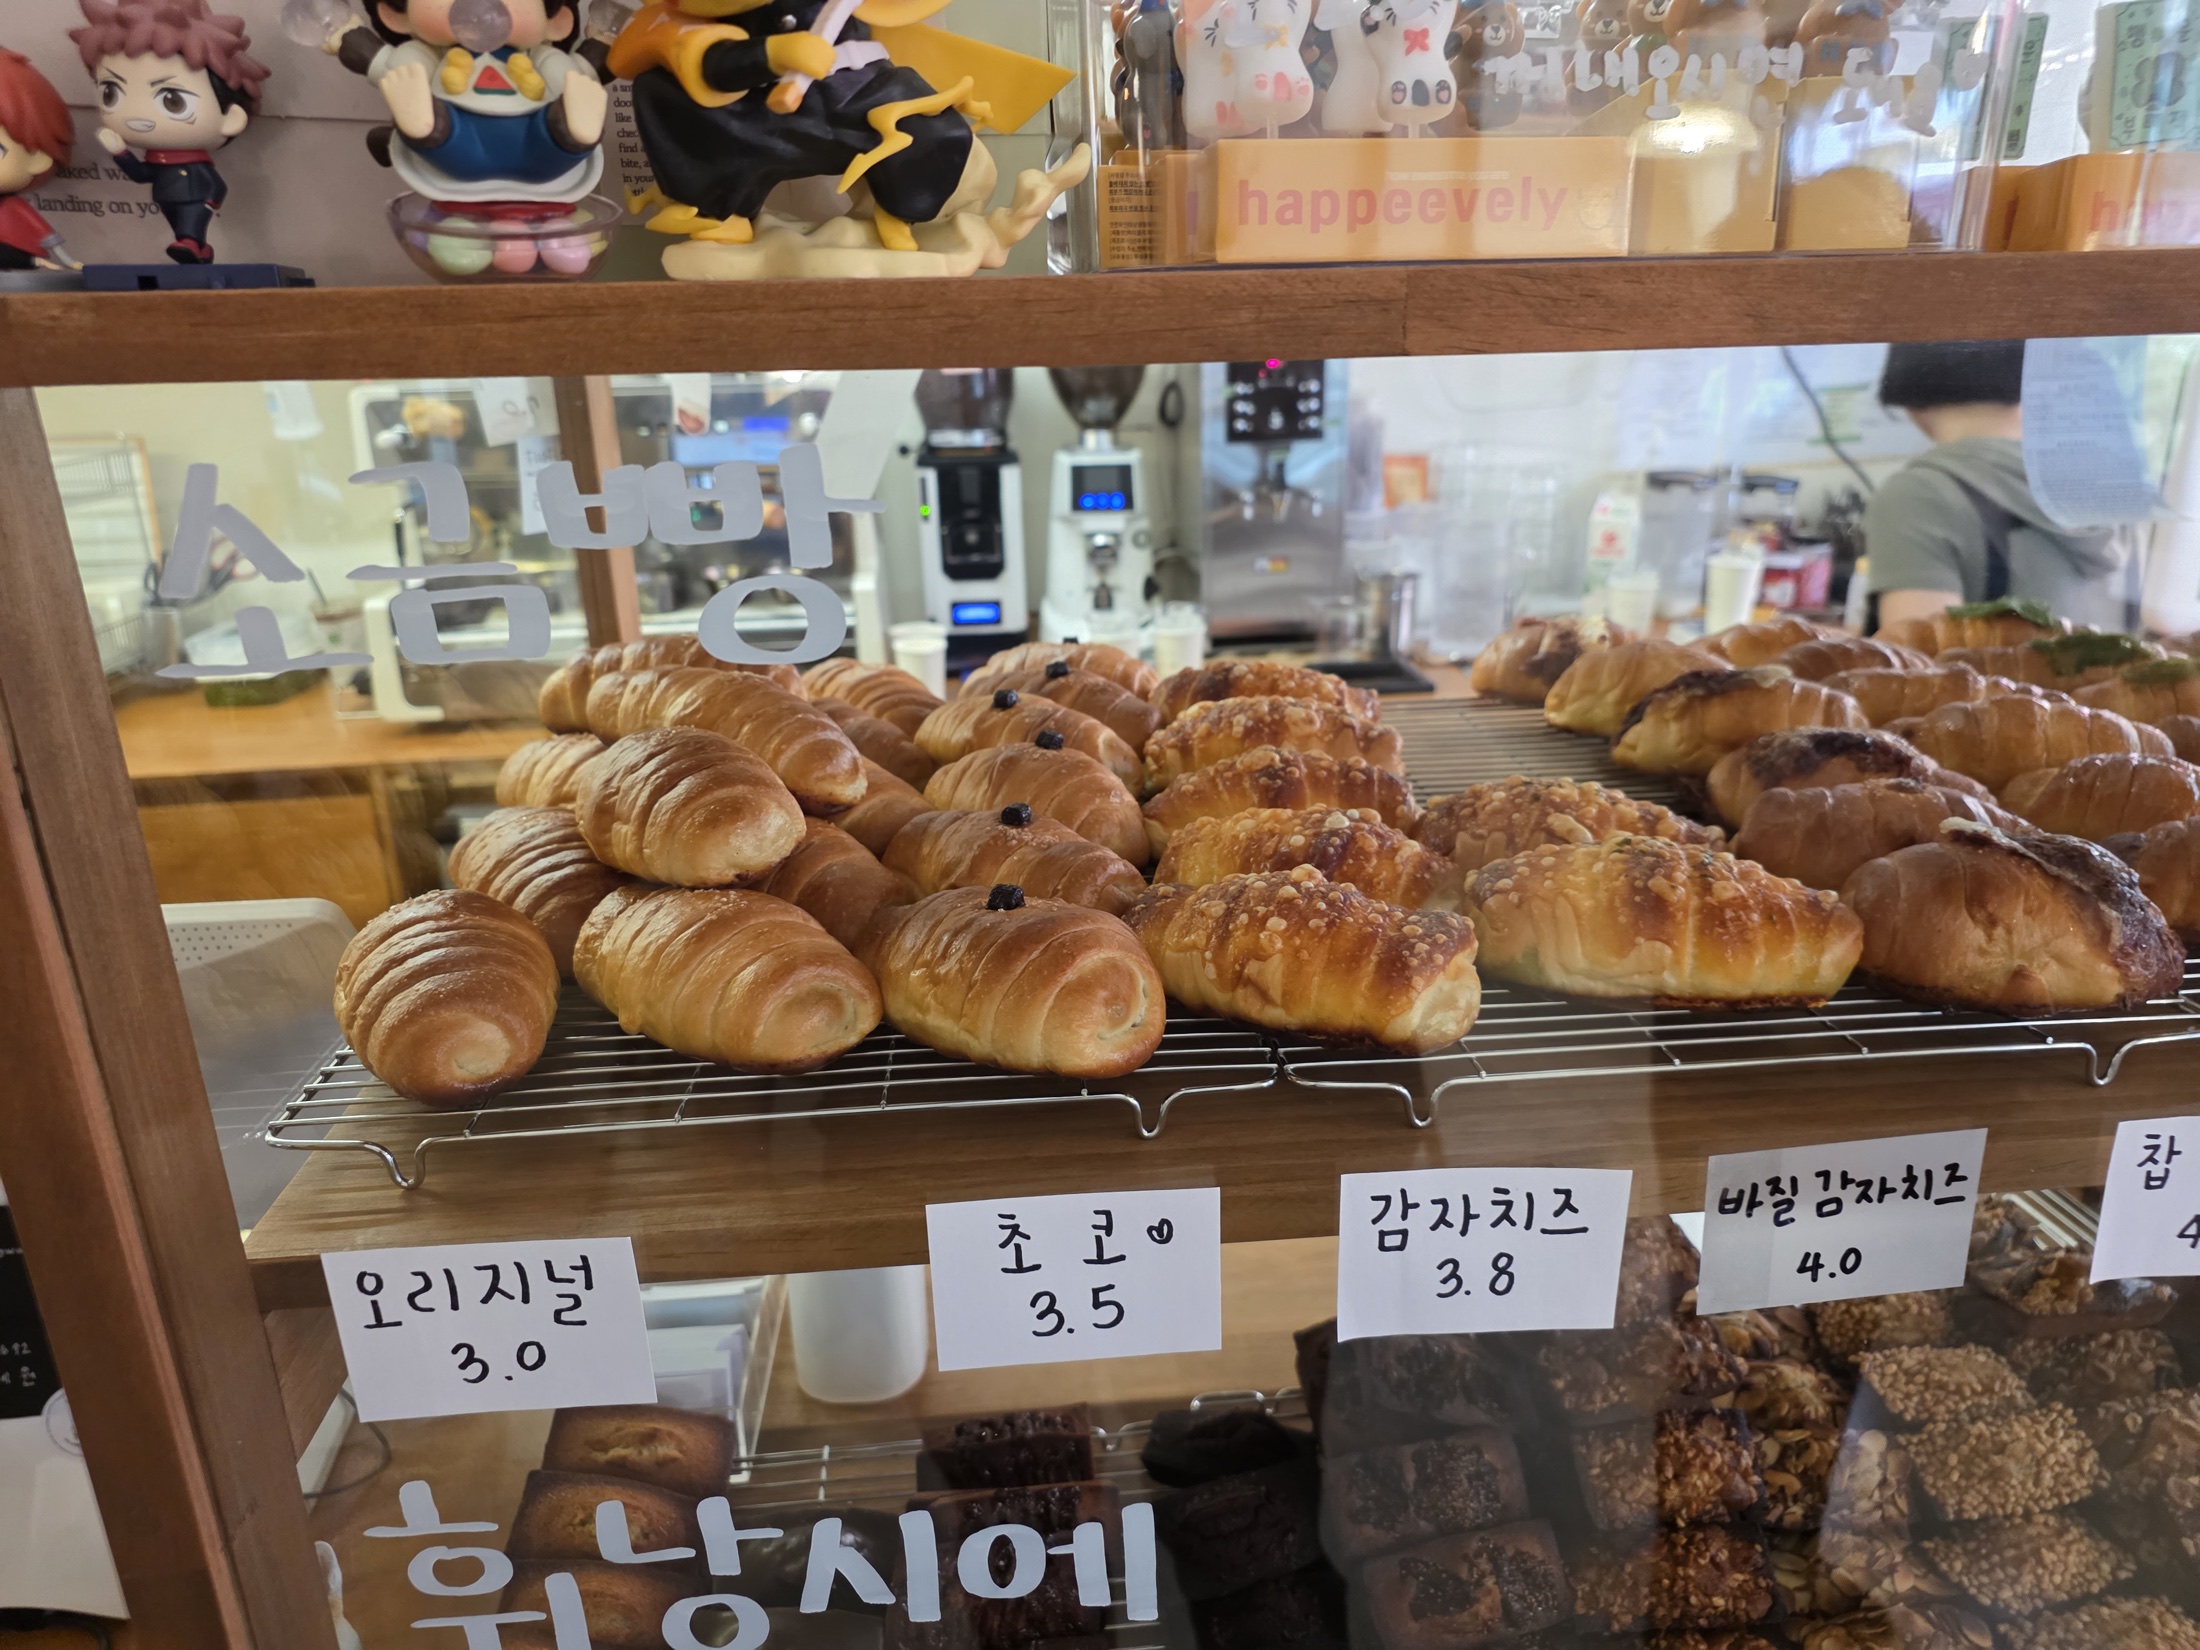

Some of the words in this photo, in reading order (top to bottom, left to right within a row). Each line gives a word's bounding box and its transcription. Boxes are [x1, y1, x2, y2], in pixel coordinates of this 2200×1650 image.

[615, 112, 632, 123] like
[619, 142, 638, 153] find
[33, 192, 105, 218] landing
[108, 201, 133, 215] on
[622, 173, 633, 183] in
[1238, 175, 1569, 234] happeevely
[155, 443, 887, 678] 소금빵
[2136, 1133, 2183, 1191] 찹
[1370, 1186, 1589, 1252] 감자치즈
[1717, 1175, 1799, 1227] 바질
[1814, 1162, 1969, 1218] 감자치즈
[1435, 1251, 1515, 1299] 3.8
[1796, 1246, 1863, 1283] 4.0
[355, 1254, 594, 1330] 오리지널
[1029, 1283, 1125, 1337] 3.5
[450, 1340, 547, 1384] 3.0
[362, 1479, 1159, 1650] 휘낭시에
